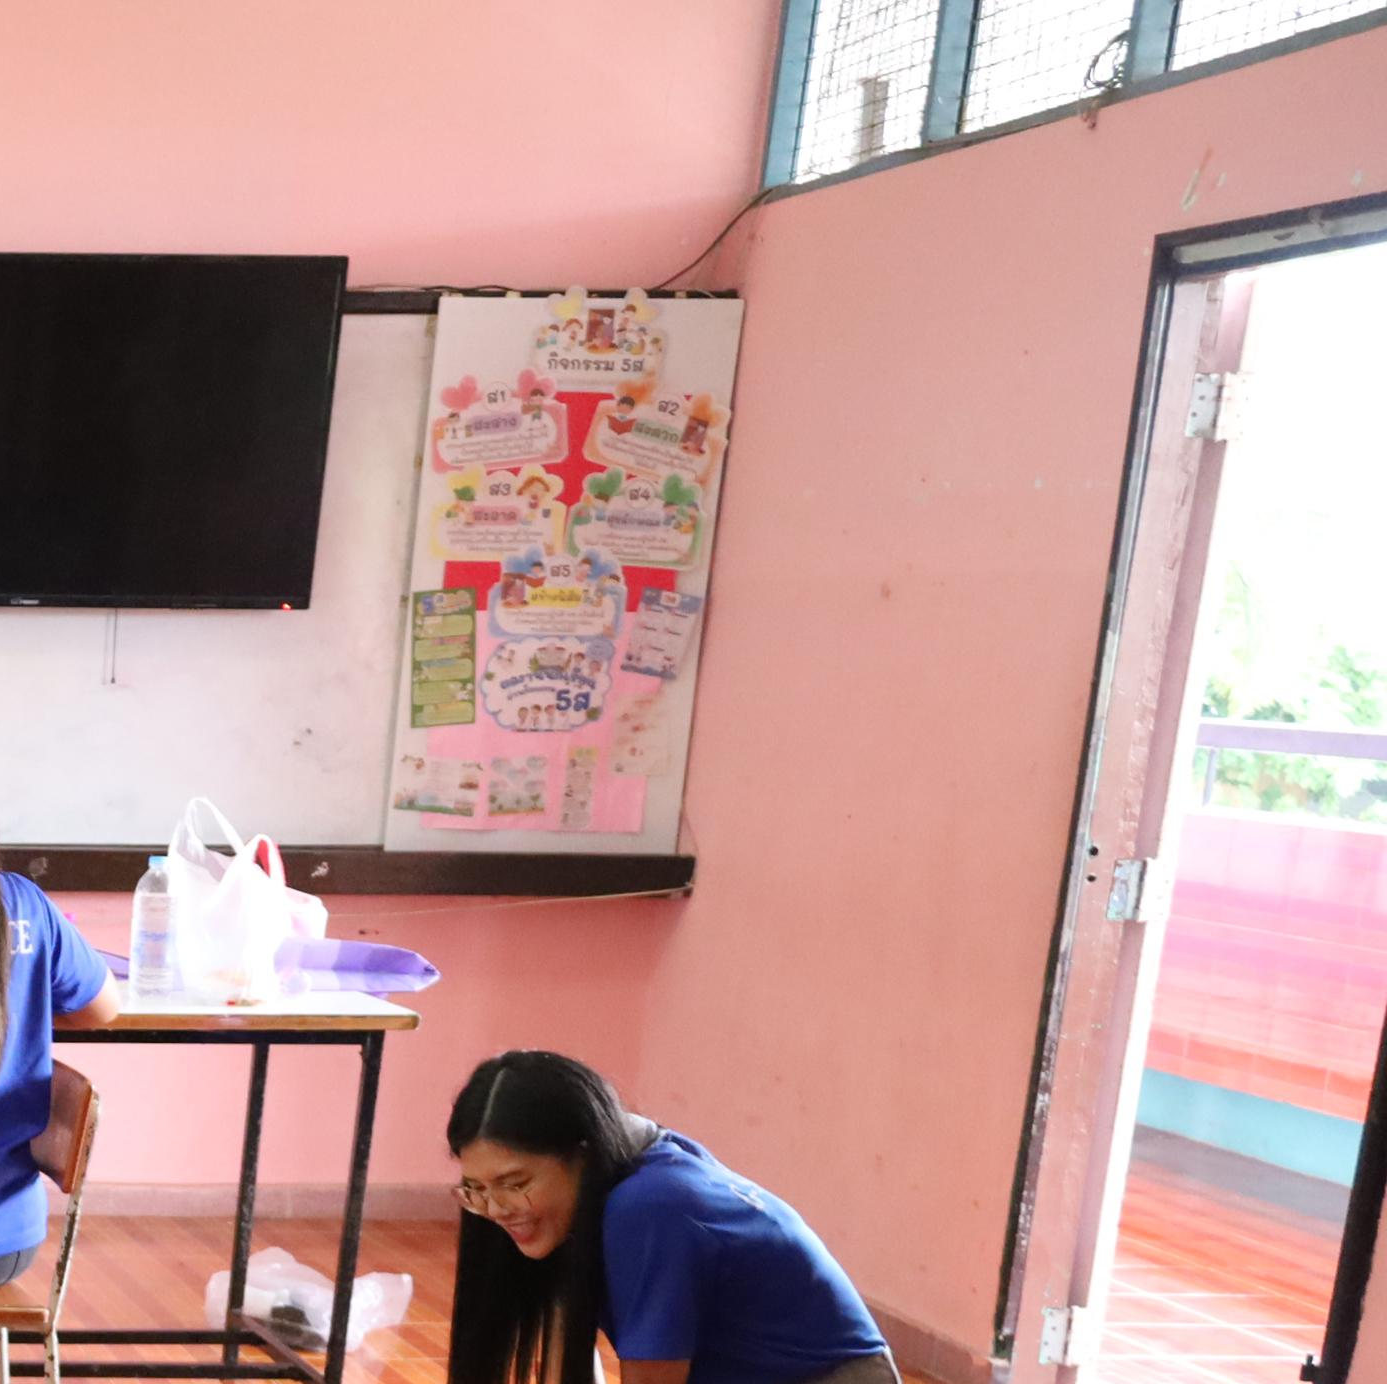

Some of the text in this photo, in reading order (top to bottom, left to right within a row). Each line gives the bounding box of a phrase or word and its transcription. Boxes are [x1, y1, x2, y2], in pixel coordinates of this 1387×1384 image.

[546, 351, 615, 371] กิจกรรม
[657, 398, 680, 416] ส2
[488, 481, 511, 497] ส3
[629, 485, 651, 501] ส4
[550, 561, 571, 578] ส5
[555, 688, 592, 712] 5ส
